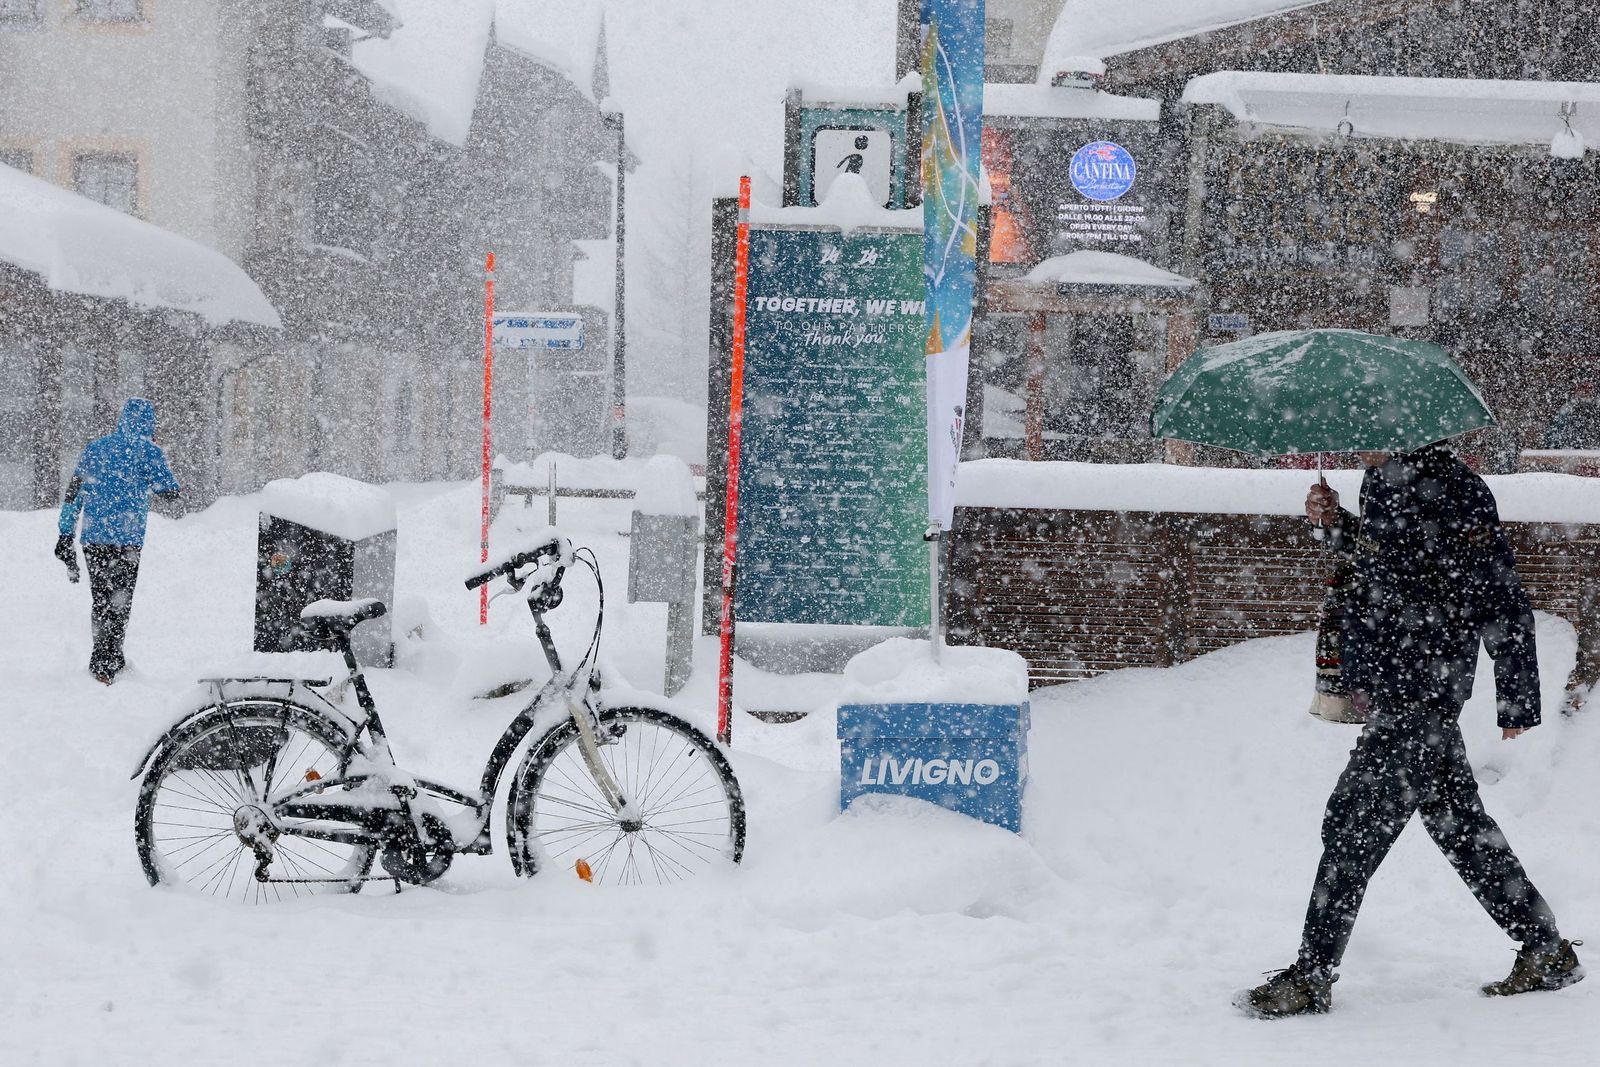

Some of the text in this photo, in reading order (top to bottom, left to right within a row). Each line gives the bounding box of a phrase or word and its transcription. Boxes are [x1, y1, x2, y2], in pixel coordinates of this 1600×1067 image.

[1074, 162, 1131, 180] CANTINA
[1059, 204, 1089, 212] APERTO
[1092, 223, 1116, 231] EVERY
[1118, 224, 1133, 232] DAY
[755, 296, 861, 316] TOGETHER,
[866, 299, 896, 315] WE
[775, 320, 916, 333] TO OUR PARTNERS
[804, 331, 853, 346] Thank
[860, 758, 1001, 785] LIVIGNO
